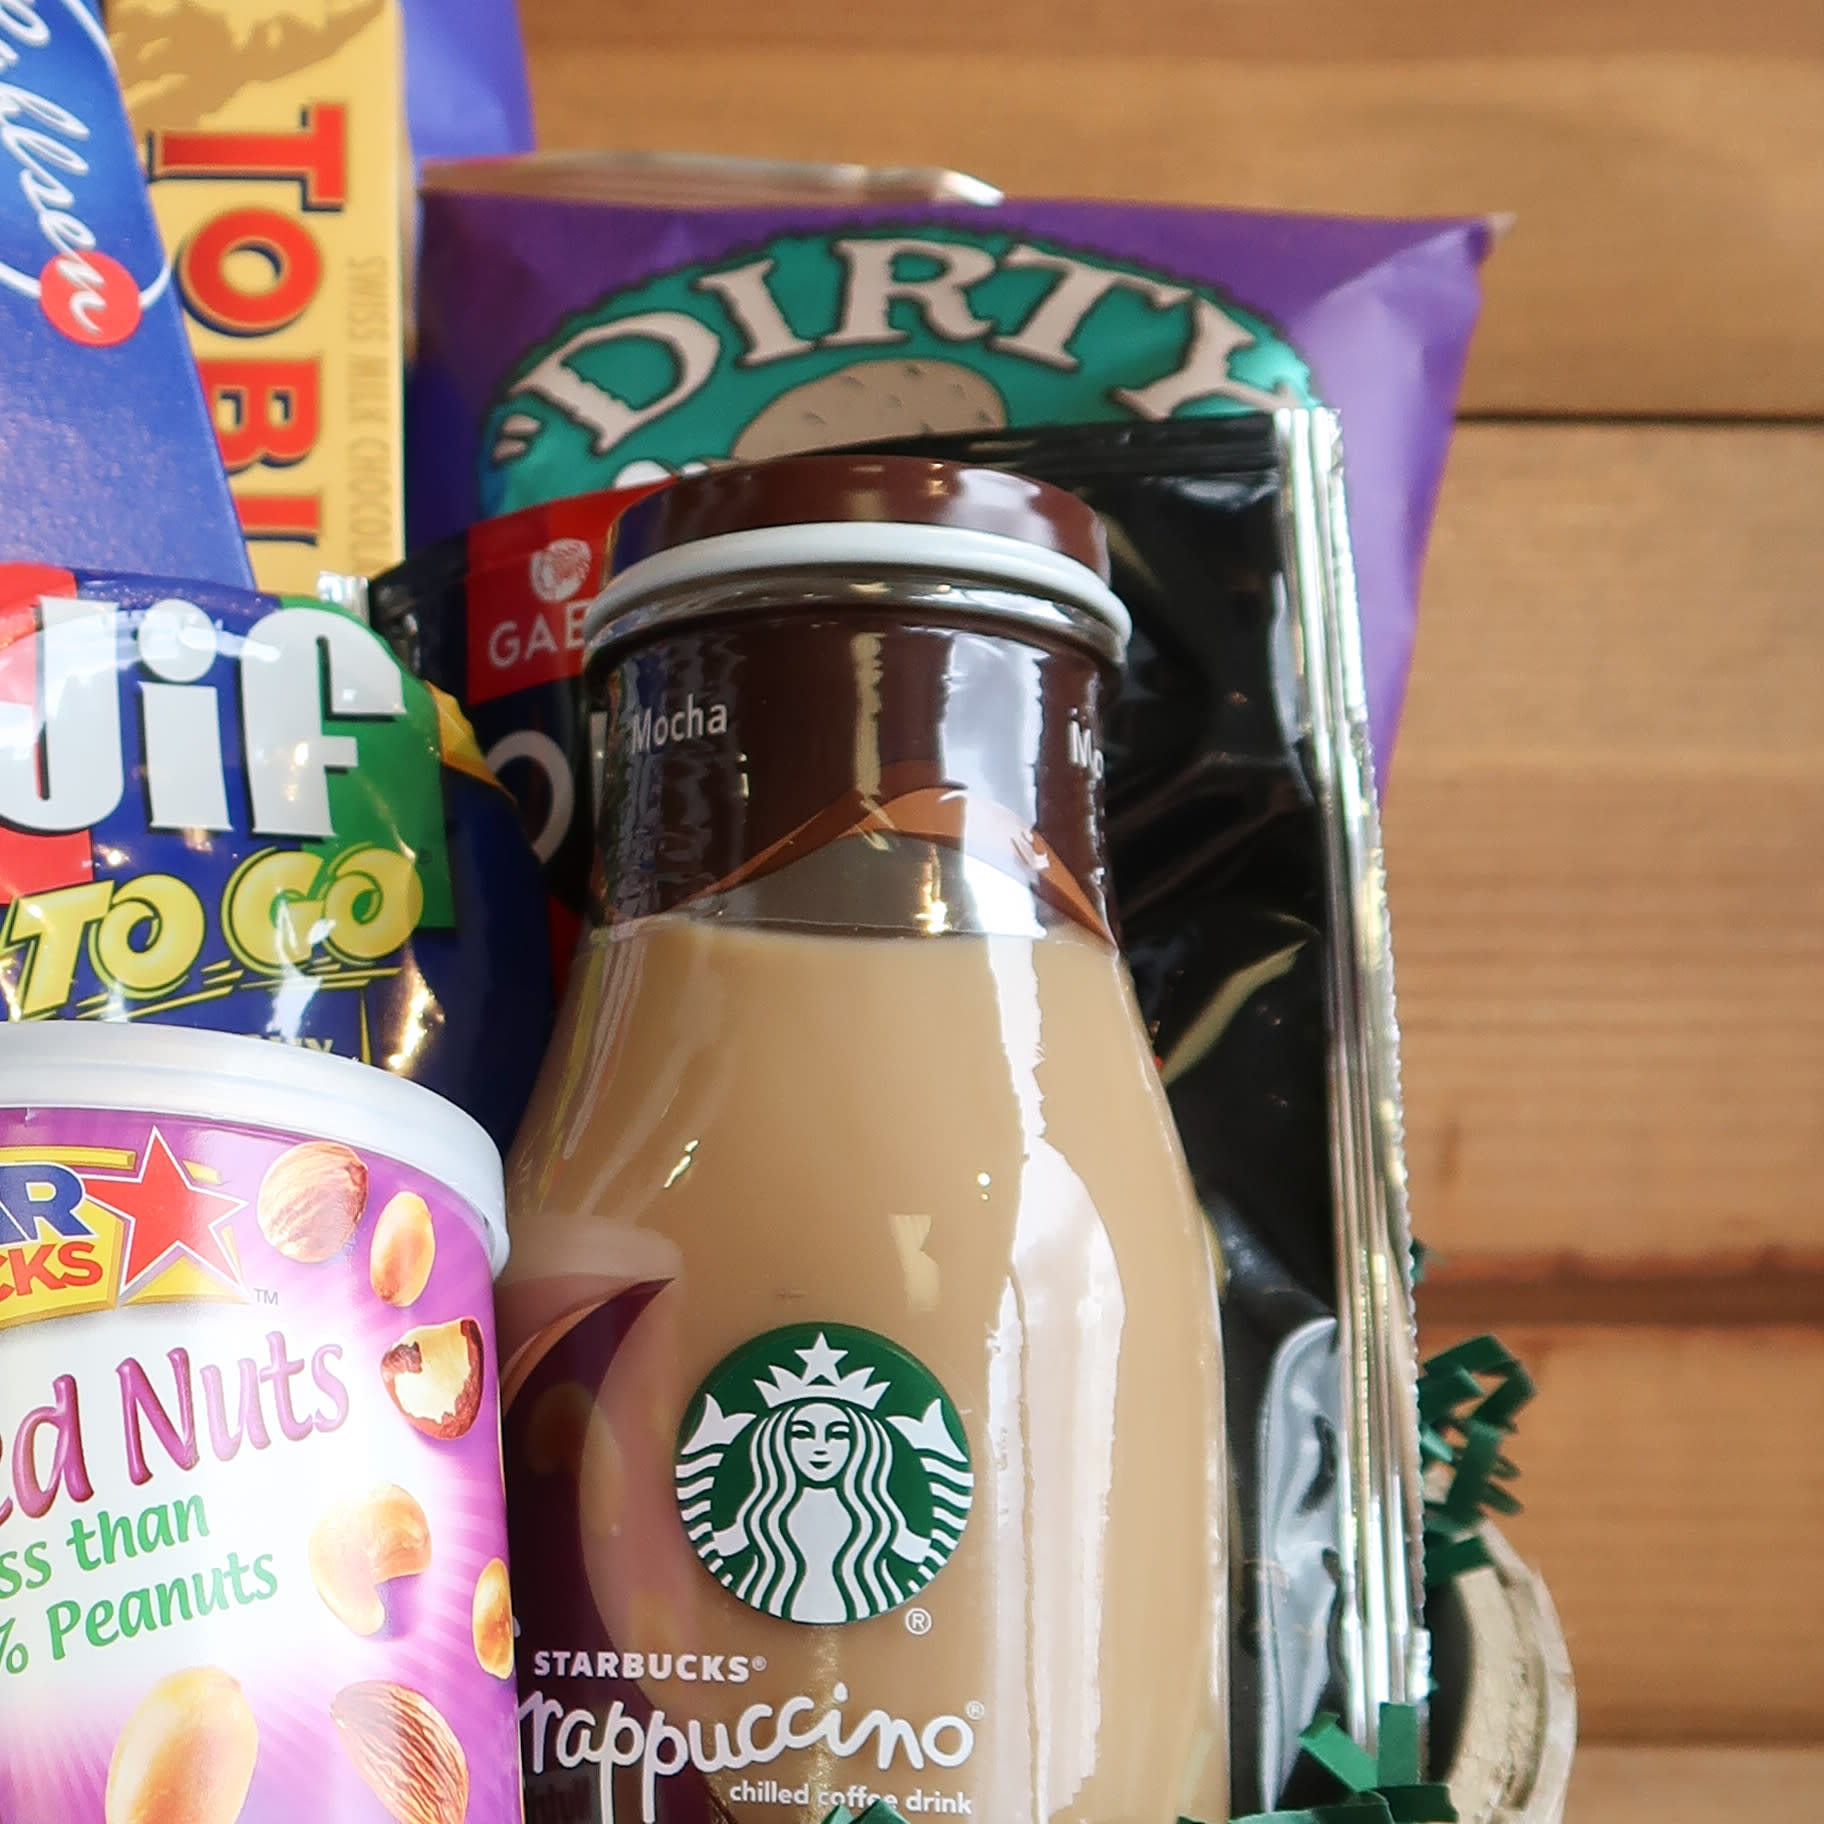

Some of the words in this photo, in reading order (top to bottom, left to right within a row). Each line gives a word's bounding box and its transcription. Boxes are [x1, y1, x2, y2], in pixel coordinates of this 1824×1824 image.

[631, 691, 728, 755] Mocha
[221, 841, 424, 973] GO
[116, 1331, 350, 1486] Nuts
[65, 1494, 211, 1572] than
[46, 1552, 279, 1661] Peanuts
[728, 1778, 810, 1807] chilled
[905, 1787, 973, 1816] drink
